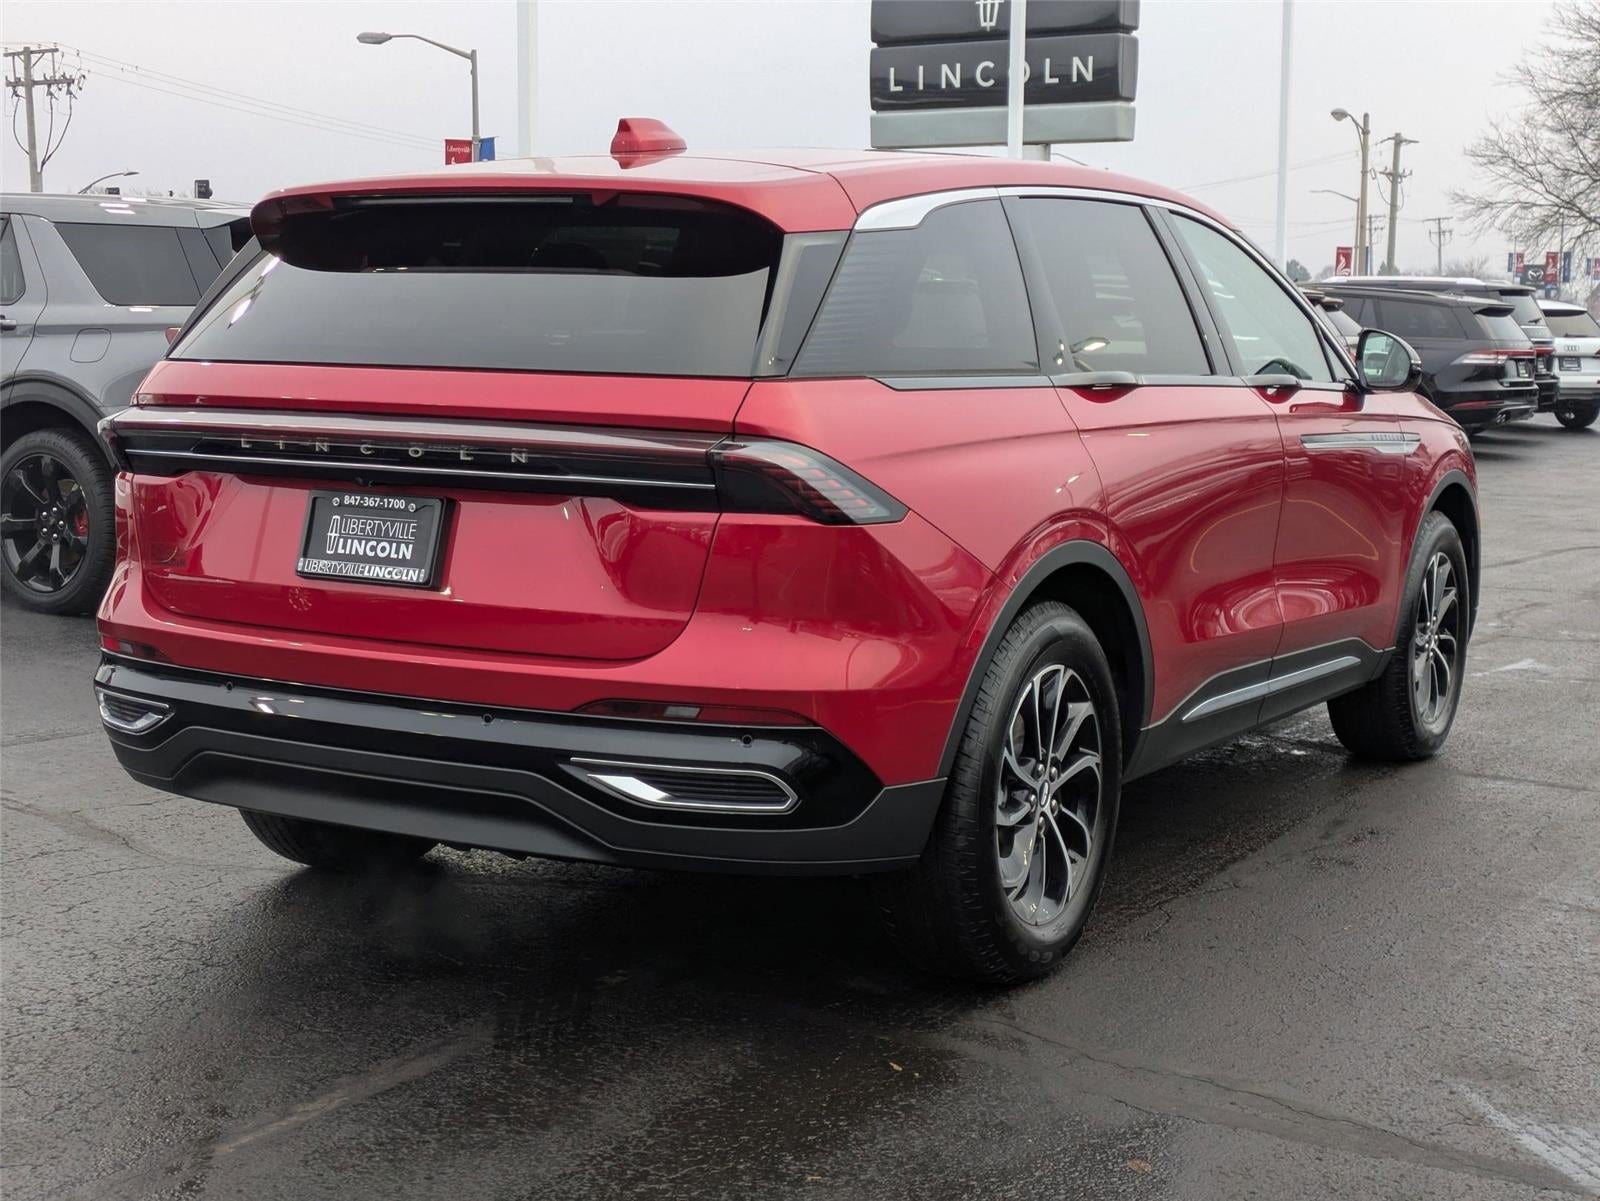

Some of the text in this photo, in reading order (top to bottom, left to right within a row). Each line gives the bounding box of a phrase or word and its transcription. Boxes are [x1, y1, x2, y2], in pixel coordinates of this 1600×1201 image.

[240, 434, 529, 464] LINCOLN
[343, 495, 406, 509] 847-367-1700
[341, 517, 417, 540] LIBERTYVILLE
[337, 538, 413, 560] LINCOLN
